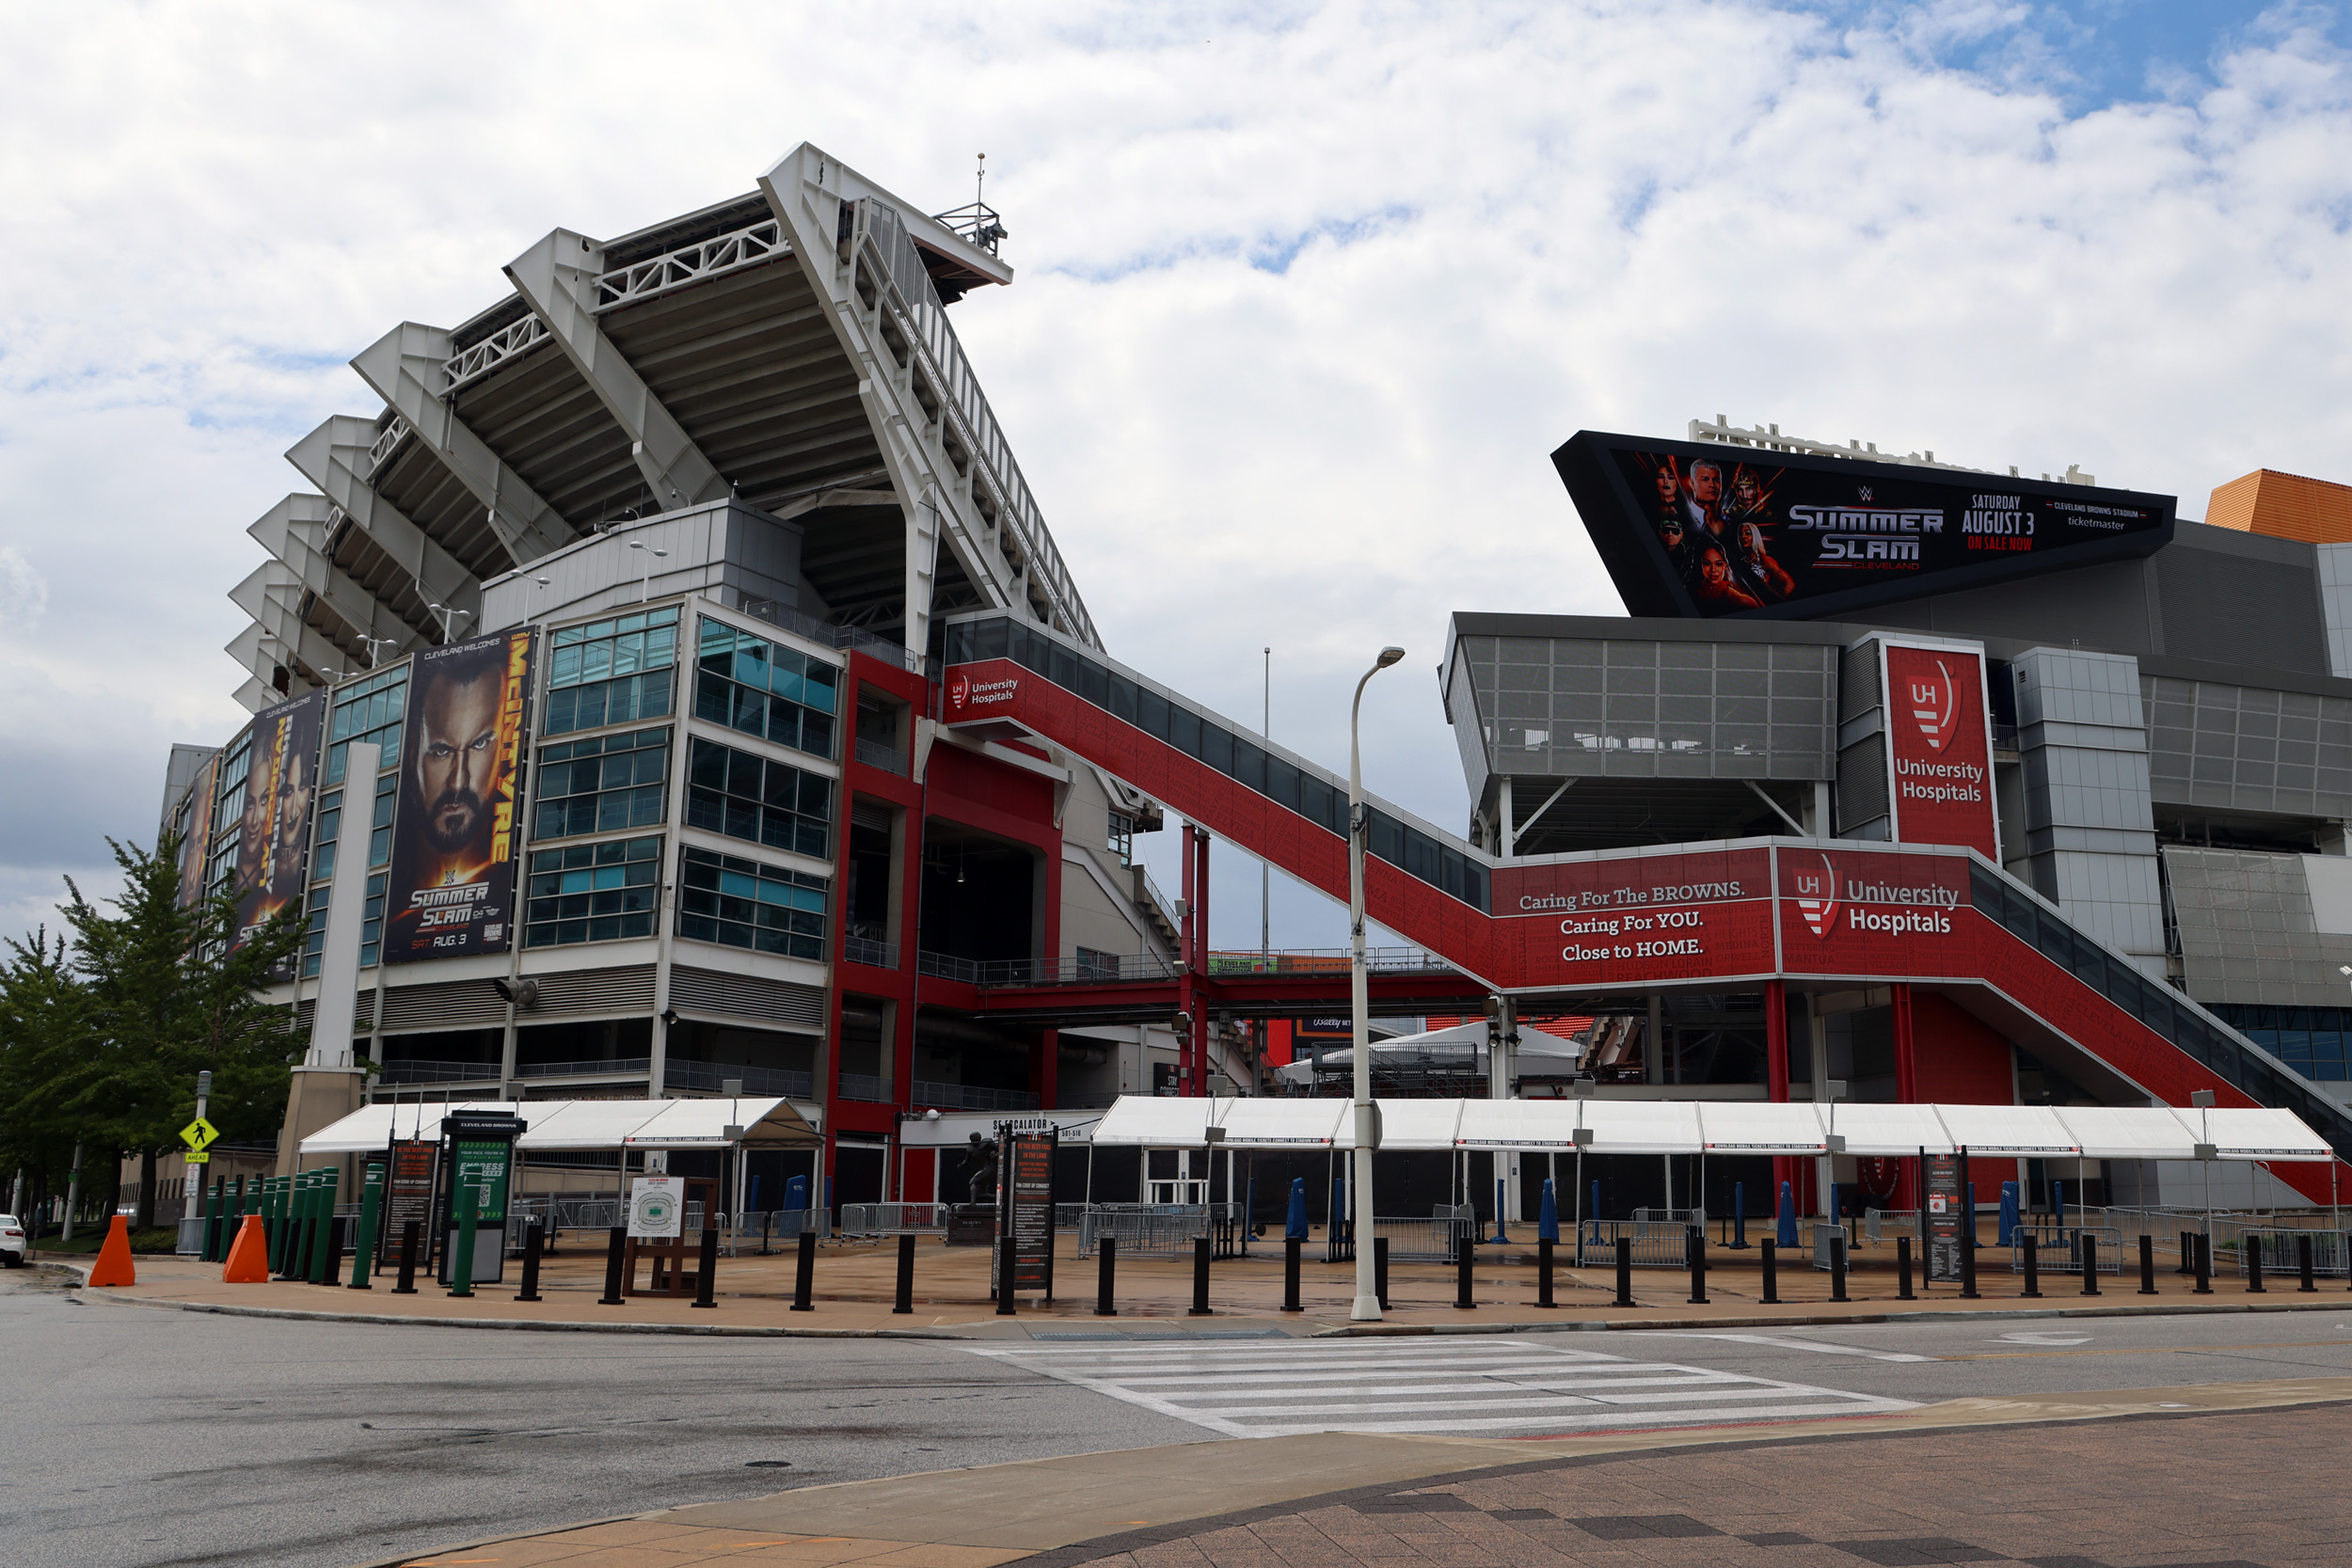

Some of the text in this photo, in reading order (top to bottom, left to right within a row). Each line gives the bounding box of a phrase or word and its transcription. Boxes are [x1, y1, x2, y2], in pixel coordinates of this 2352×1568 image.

[1972, 495, 2020, 510] SATURDAY
[2054, 501, 2138, 517] CLEVELAND BROWNS STADIUM
[1788, 505, 1944, 532] SUMMER
[1963, 510, 2035, 535] AUGUST 3
[2068, 517, 2124, 530] ticketmaster
[1819, 534, 1919, 560] SLAM
[1967, 536, 2032, 551] ON SALE NOW
[1853, 562, 1919, 570] CLEVELAND
[424, 638, 501, 660] CLEVELAND WELCOMES
[972, 679, 1018, 692] University
[1912, 684, 1936, 704] UH
[972, 690, 1013, 704] Hospitals
[266, 696, 310, 719] CLEVELAND WELCOMES
[1085, 723, 1150, 764] CLEVELAND
[1159, 751, 1200, 779] GENEVA
[1896, 758, 1983, 784] University
[1902, 781, 1981, 803] Hospitals
[1215, 813, 1256, 843] ELYRIA
[1286, 831, 1317, 852] MEDINA
[1699, 850, 1770, 866] ASHLAND
[408, 881, 489, 909] SUMMER
[1797, 876, 1820, 894] UH
[1848, 879, 1960, 911] University
[1519, 881, 1745, 911] Caring For The BROWNS.
[420, 903, 473, 927] SLAM
[1703, 903, 1764, 915] MANSFIELD
[1561, 917, 1619, 936] Caring
[1624, 915, 1653, 930] For
[1656, 911, 1704, 928] YOU.
[1850, 909, 1951, 936] Hospitals
[411, 933, 467, 950] SAT. AUG. 3
[1714, 927, 1757, 939] HEIGHTS
[1760, 914, 1770, 958] NORTH
[1563, 939, 1704, 961] Close to HOME.
[1715, 941, 1758, 950] MEDINA
[1784, 943, 1835, 952] KETTERING
[1616, 959, 1670, 972] HUDSON
[1672, 957, 1713, 969] LORAIN
[1715, 953, 1761, 962] ORWELL
[1784, 954, 1836, 965] MANTUA
[2075, 1002, 2140, 1052] CLEVELAND
[1168, 1075, 1177, 1086] STAY
